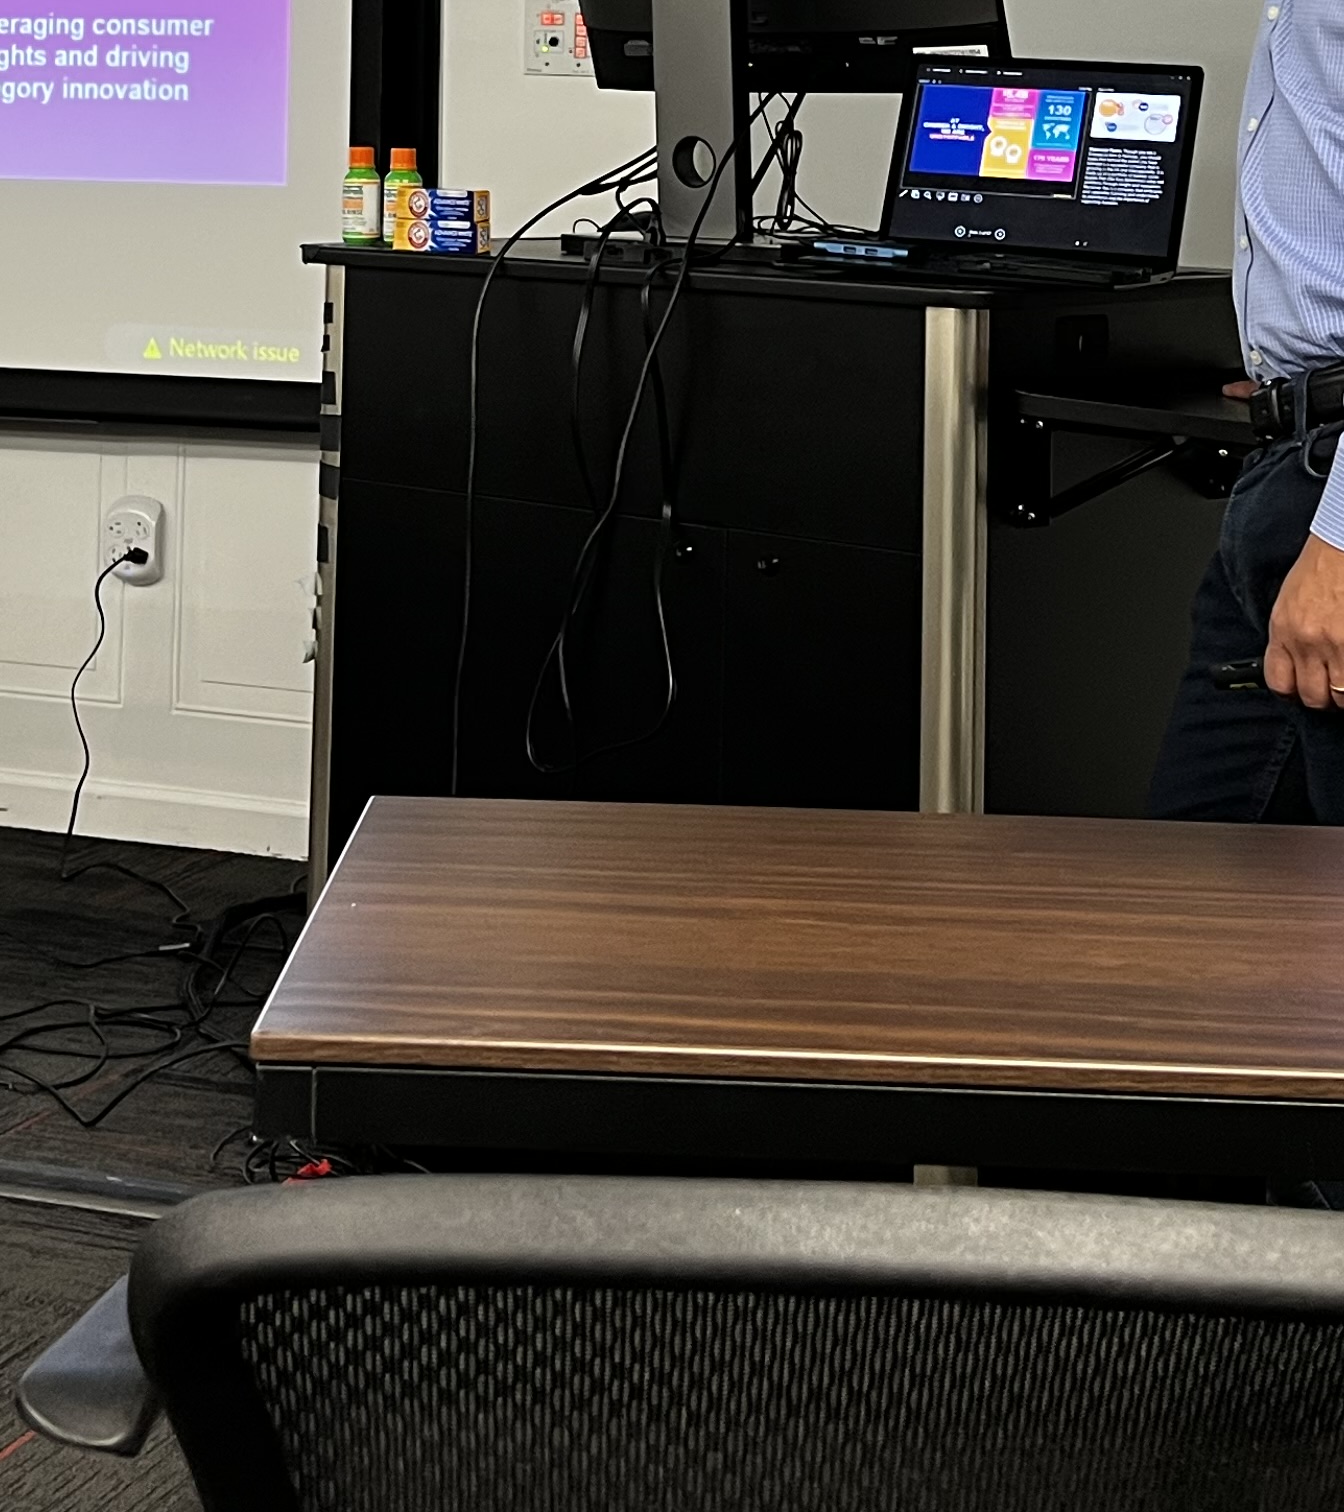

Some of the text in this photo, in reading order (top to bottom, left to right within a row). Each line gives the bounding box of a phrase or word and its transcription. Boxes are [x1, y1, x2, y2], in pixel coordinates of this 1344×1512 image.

[92, 16, 215, 37] consumer
[54, 45, 98, 67] and
[105, 44, 190, 74] driving
[62, 76, 189, 102] innovation
[169, 337, 300, 362] Network issue
